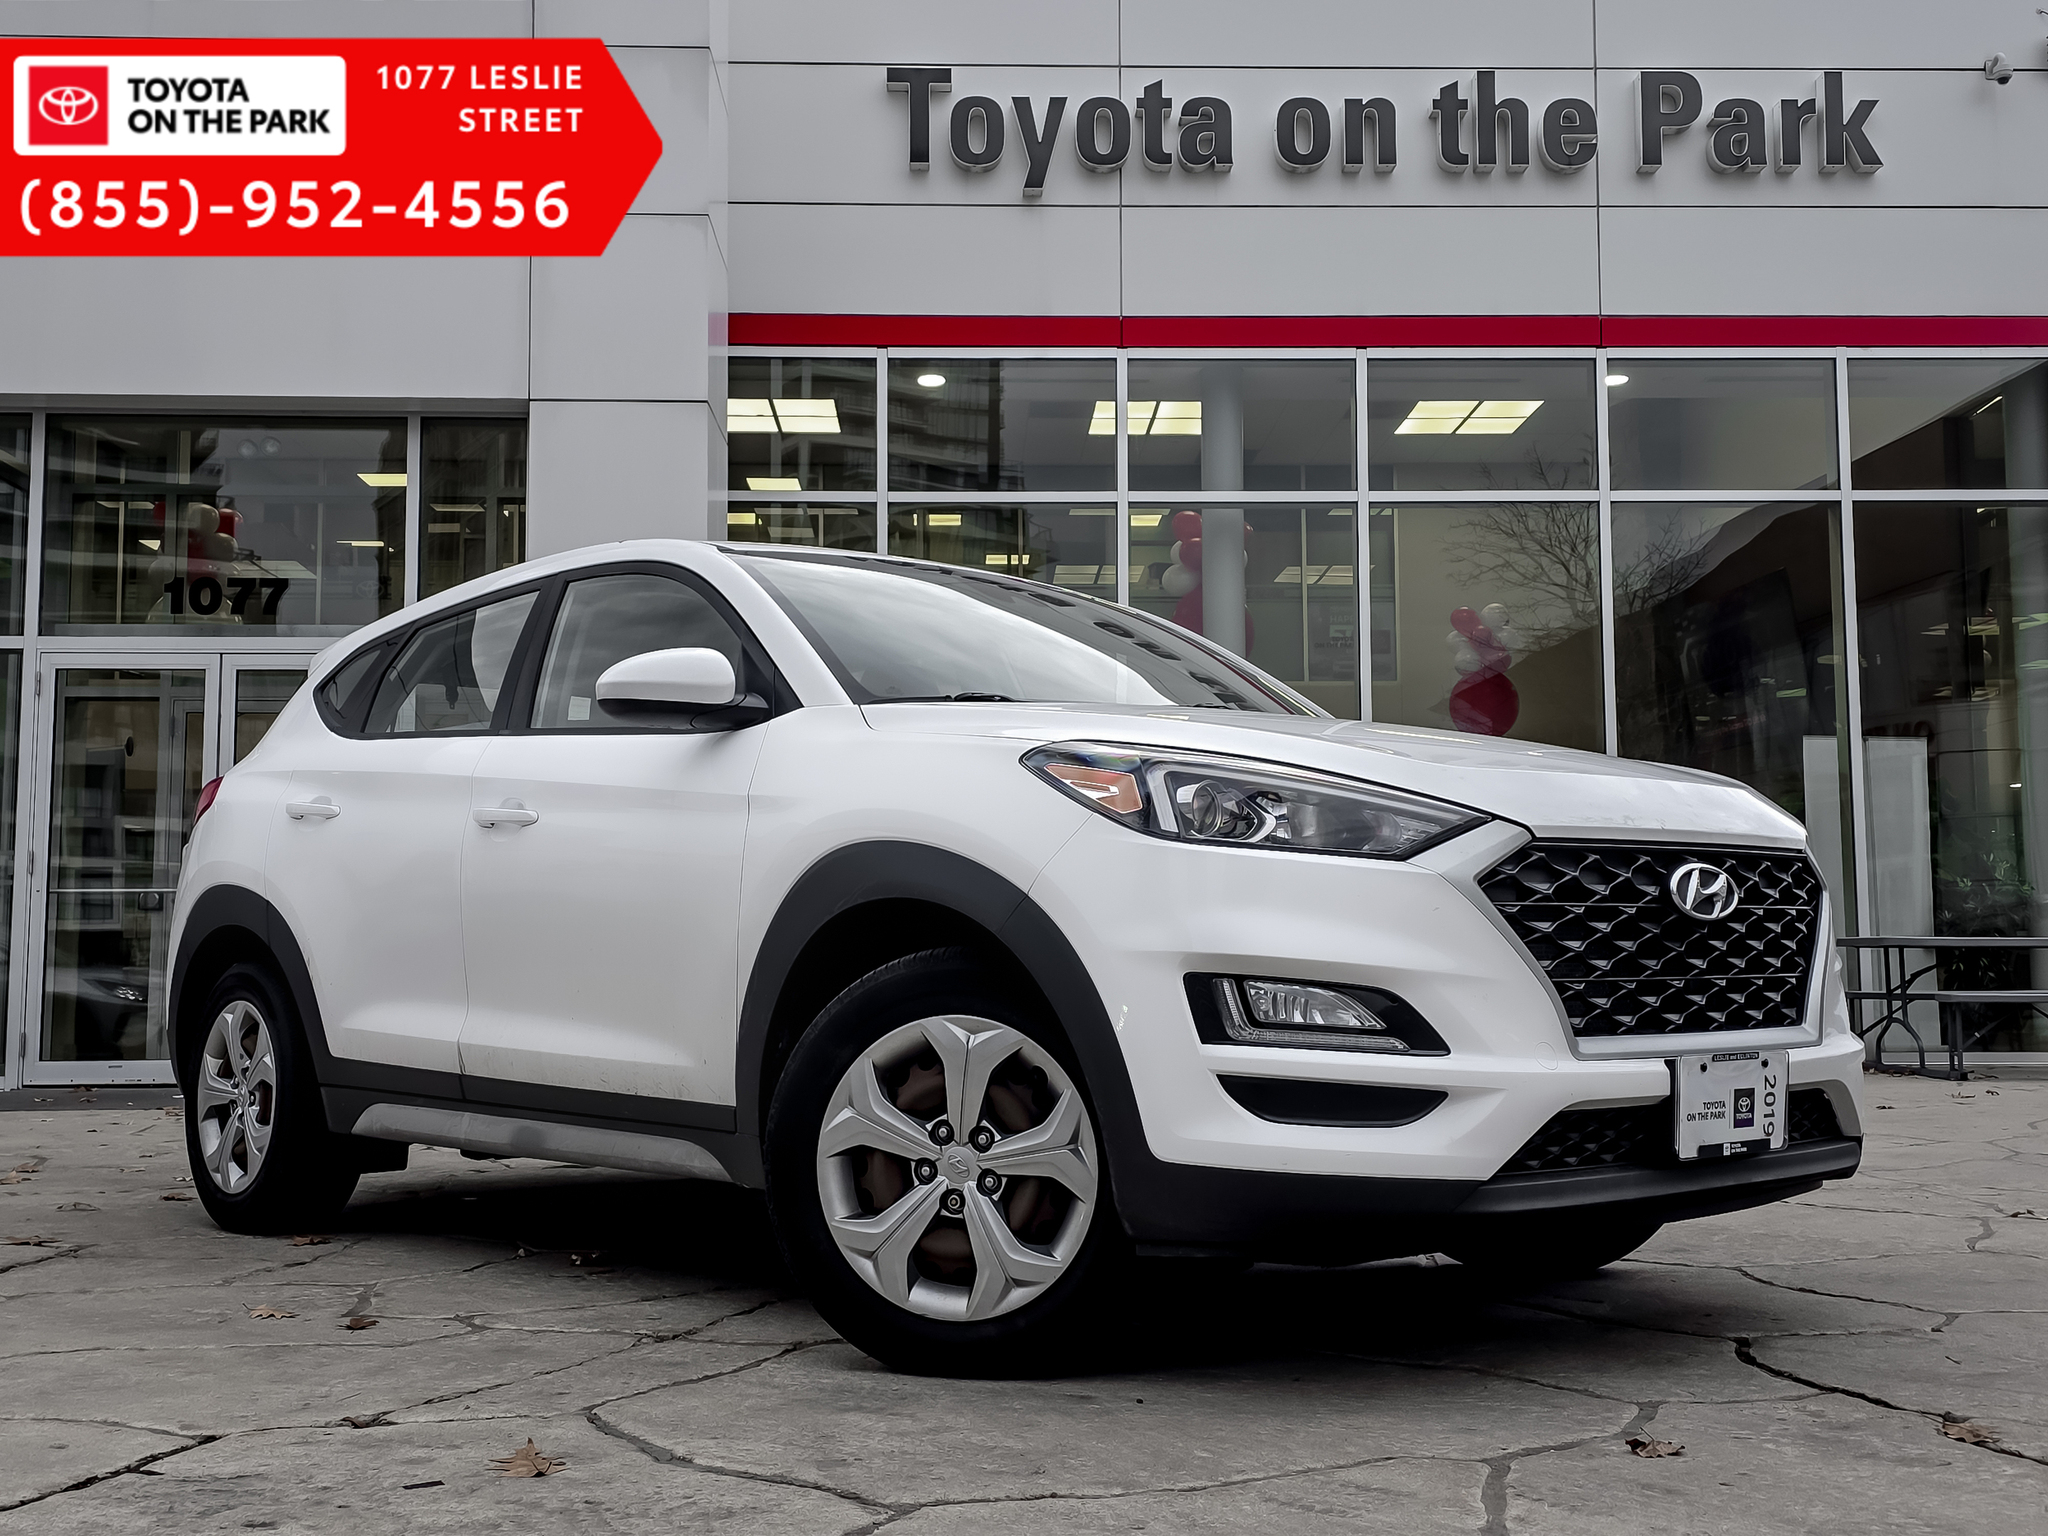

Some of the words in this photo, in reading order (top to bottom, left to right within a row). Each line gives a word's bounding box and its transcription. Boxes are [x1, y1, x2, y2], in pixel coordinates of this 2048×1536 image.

[886, 67, 1233, 198] Toyota
[1274, 94, 1398, 174] on
[1429, 69, 1599, 174] the
[1632, 69, 1884, 175] Park
[164, 577, 289, 615] 1077
[1686, 1112, 1697, 1122] ON
[1697, 1111, 1709, 1121] THE
[1710, 1110, 1726, 1120] PARK
[1703, 1101, 1726, 1111] TOYOTA
[1763, 1074, 1777, 1137] 2019
